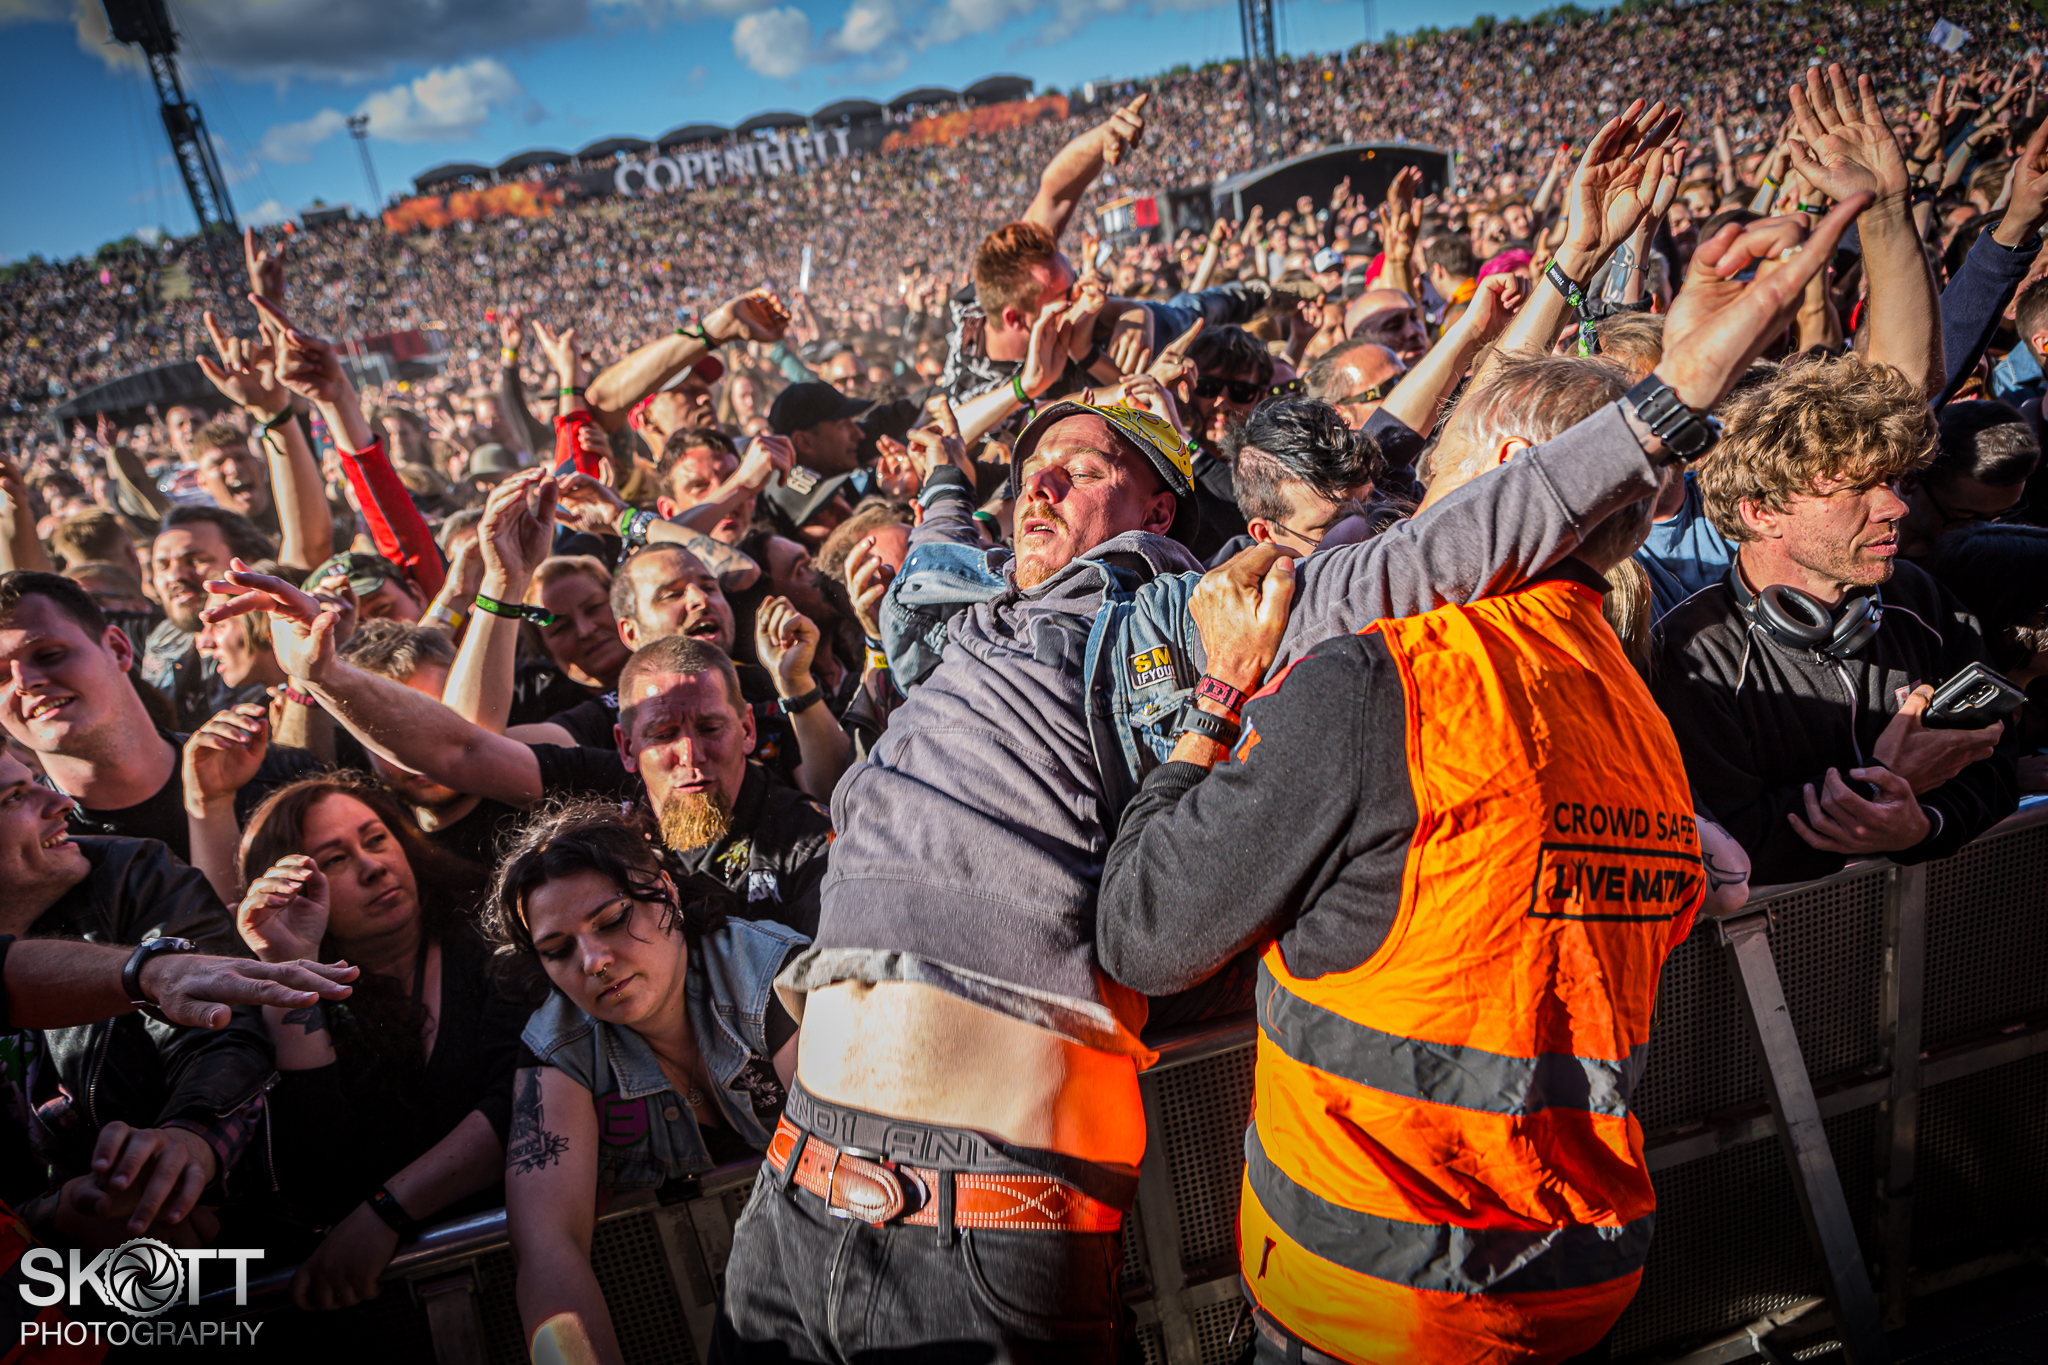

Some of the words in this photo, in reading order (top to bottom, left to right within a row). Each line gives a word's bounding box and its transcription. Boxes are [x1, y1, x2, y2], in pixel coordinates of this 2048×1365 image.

[1553, 801, 1650, 840] CROWD
[1551, 856, 1626, 905] LIVE
[604, 1099, 637, 1138] E
